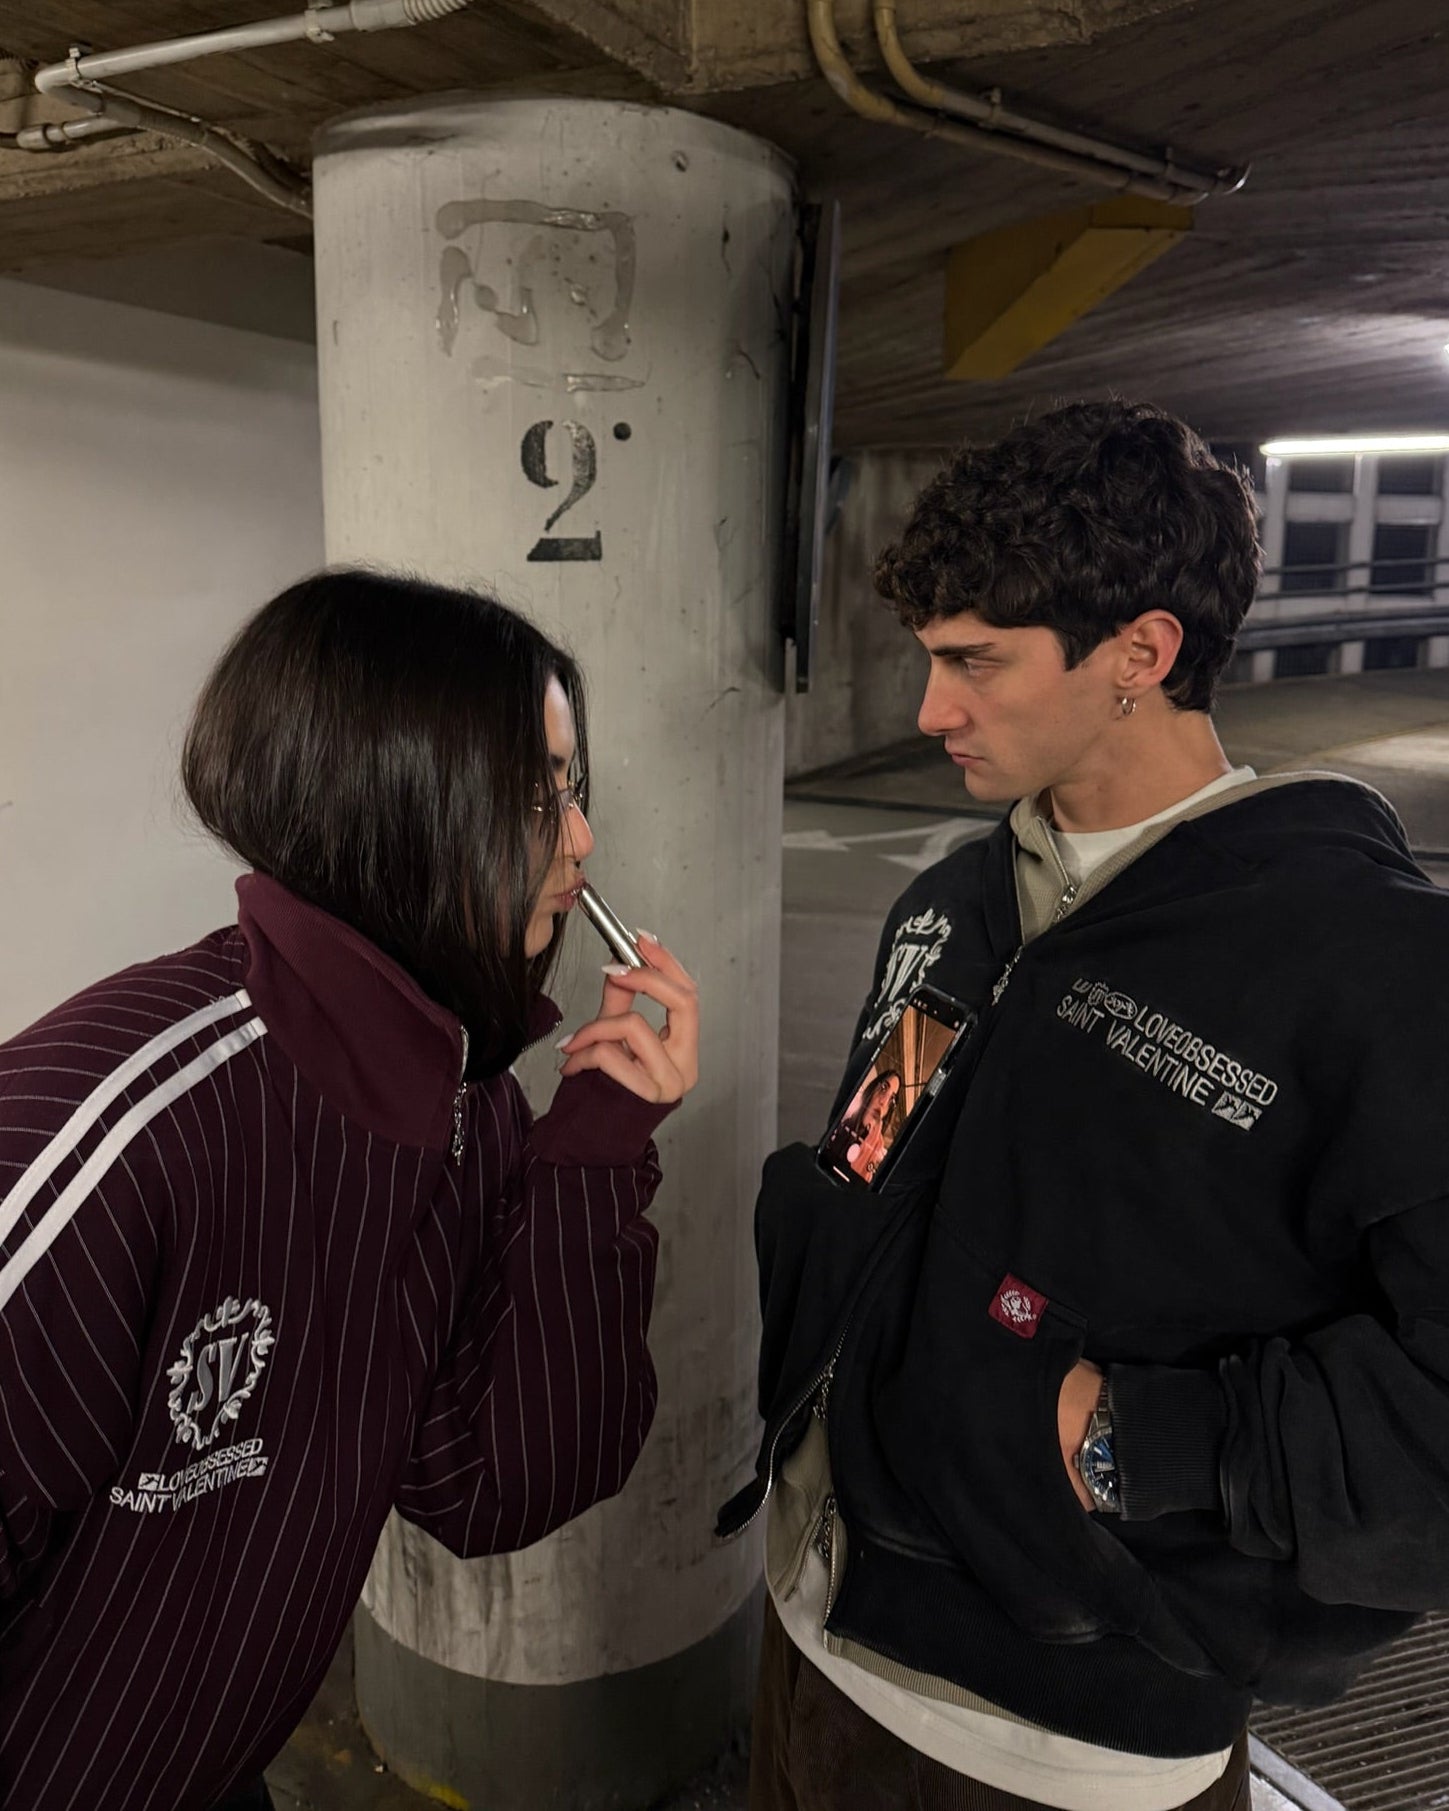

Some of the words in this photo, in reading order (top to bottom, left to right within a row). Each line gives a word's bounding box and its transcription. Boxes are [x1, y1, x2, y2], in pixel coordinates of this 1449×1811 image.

[1056, 995, 1105, 1034] SAINT
[1105, 1019, 1215, 1106] VALENTINE
[1133, 1005, 1278, 1106] LOVEOBSESSED
[186, 1332, 249, 1414] SV
[109, 1487, 172, 1513] SAINT
[171, 1460, 250, 1511] VALENTINE
[157, 1437, 263, 1492] LOVEOBSESSED
